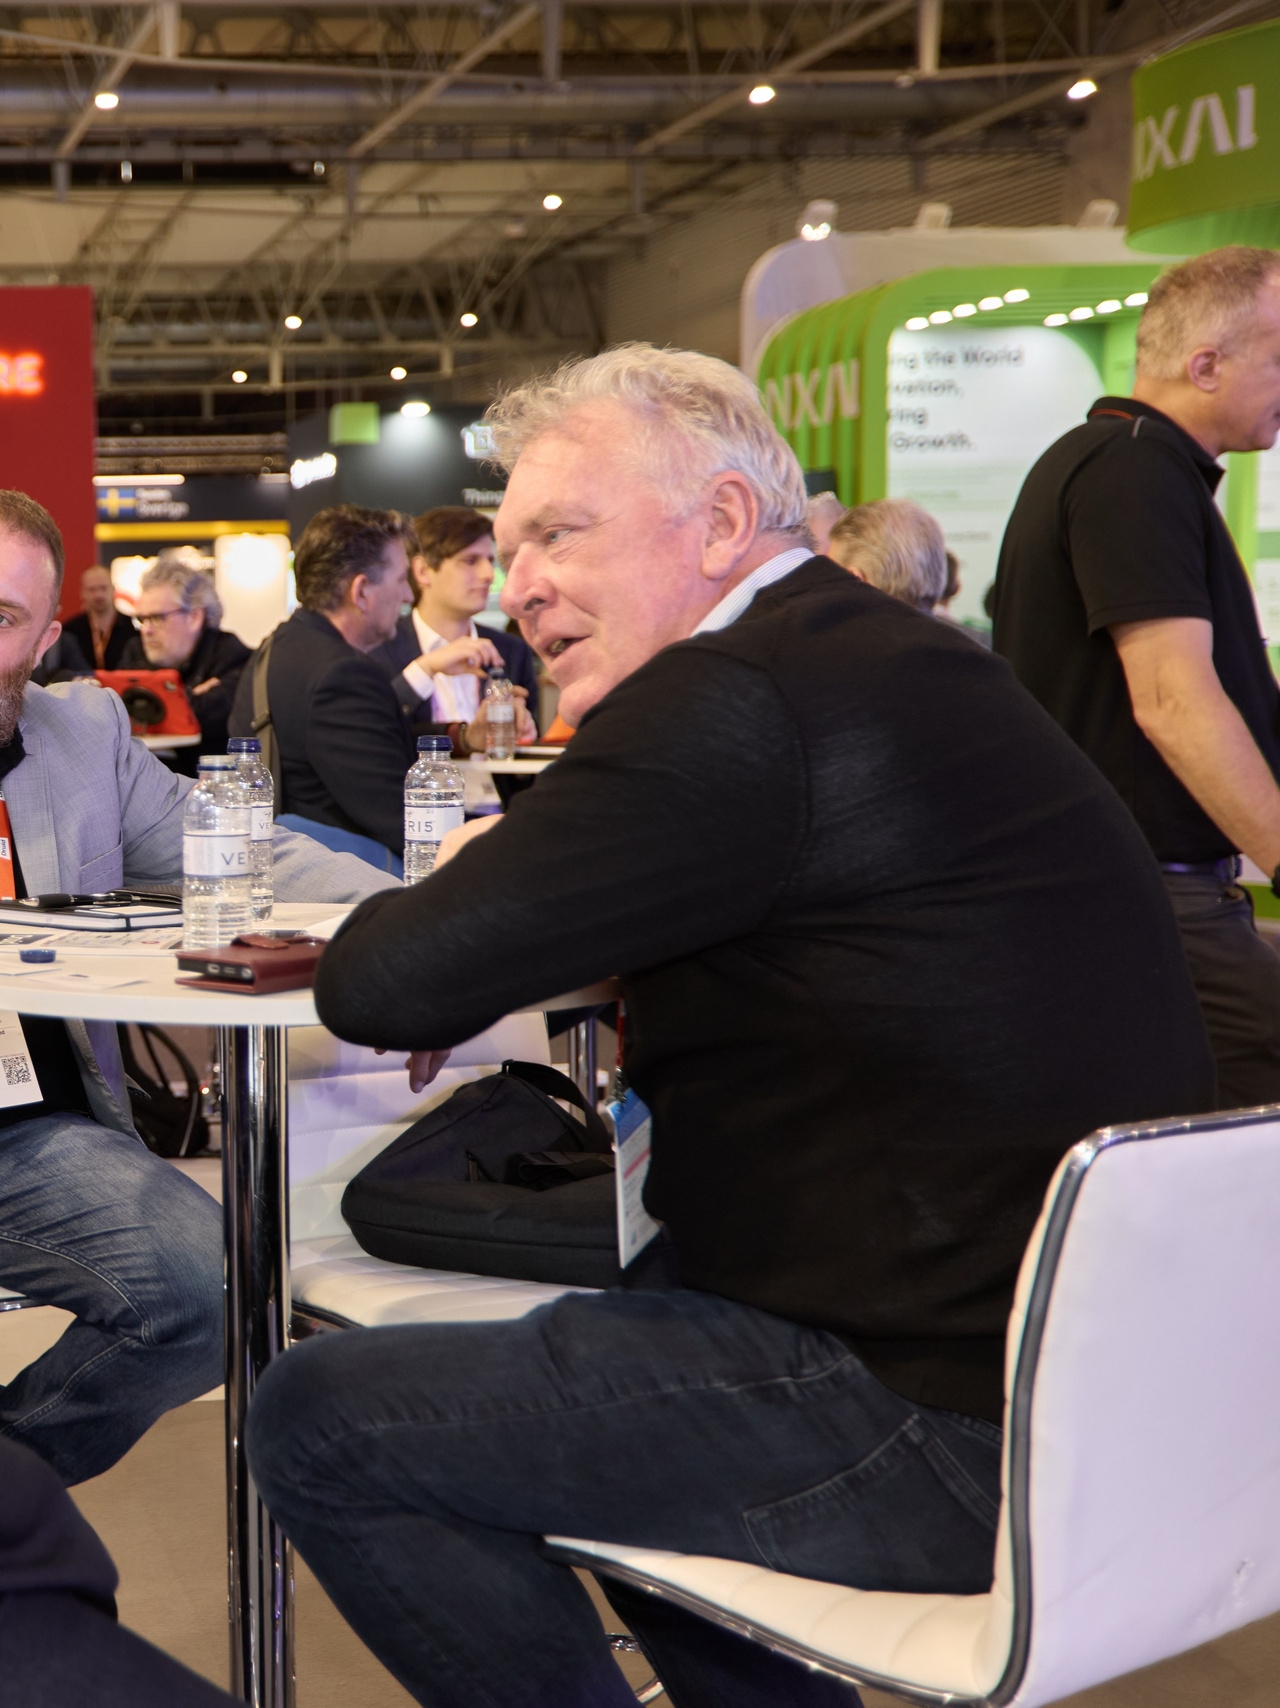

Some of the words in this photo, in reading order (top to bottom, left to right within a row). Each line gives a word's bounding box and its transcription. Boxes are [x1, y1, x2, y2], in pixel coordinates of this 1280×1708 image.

[923, 347, 957, 368] the
[960, 346, 1023, 368] World
[404, 820, 433, 832] RI5
